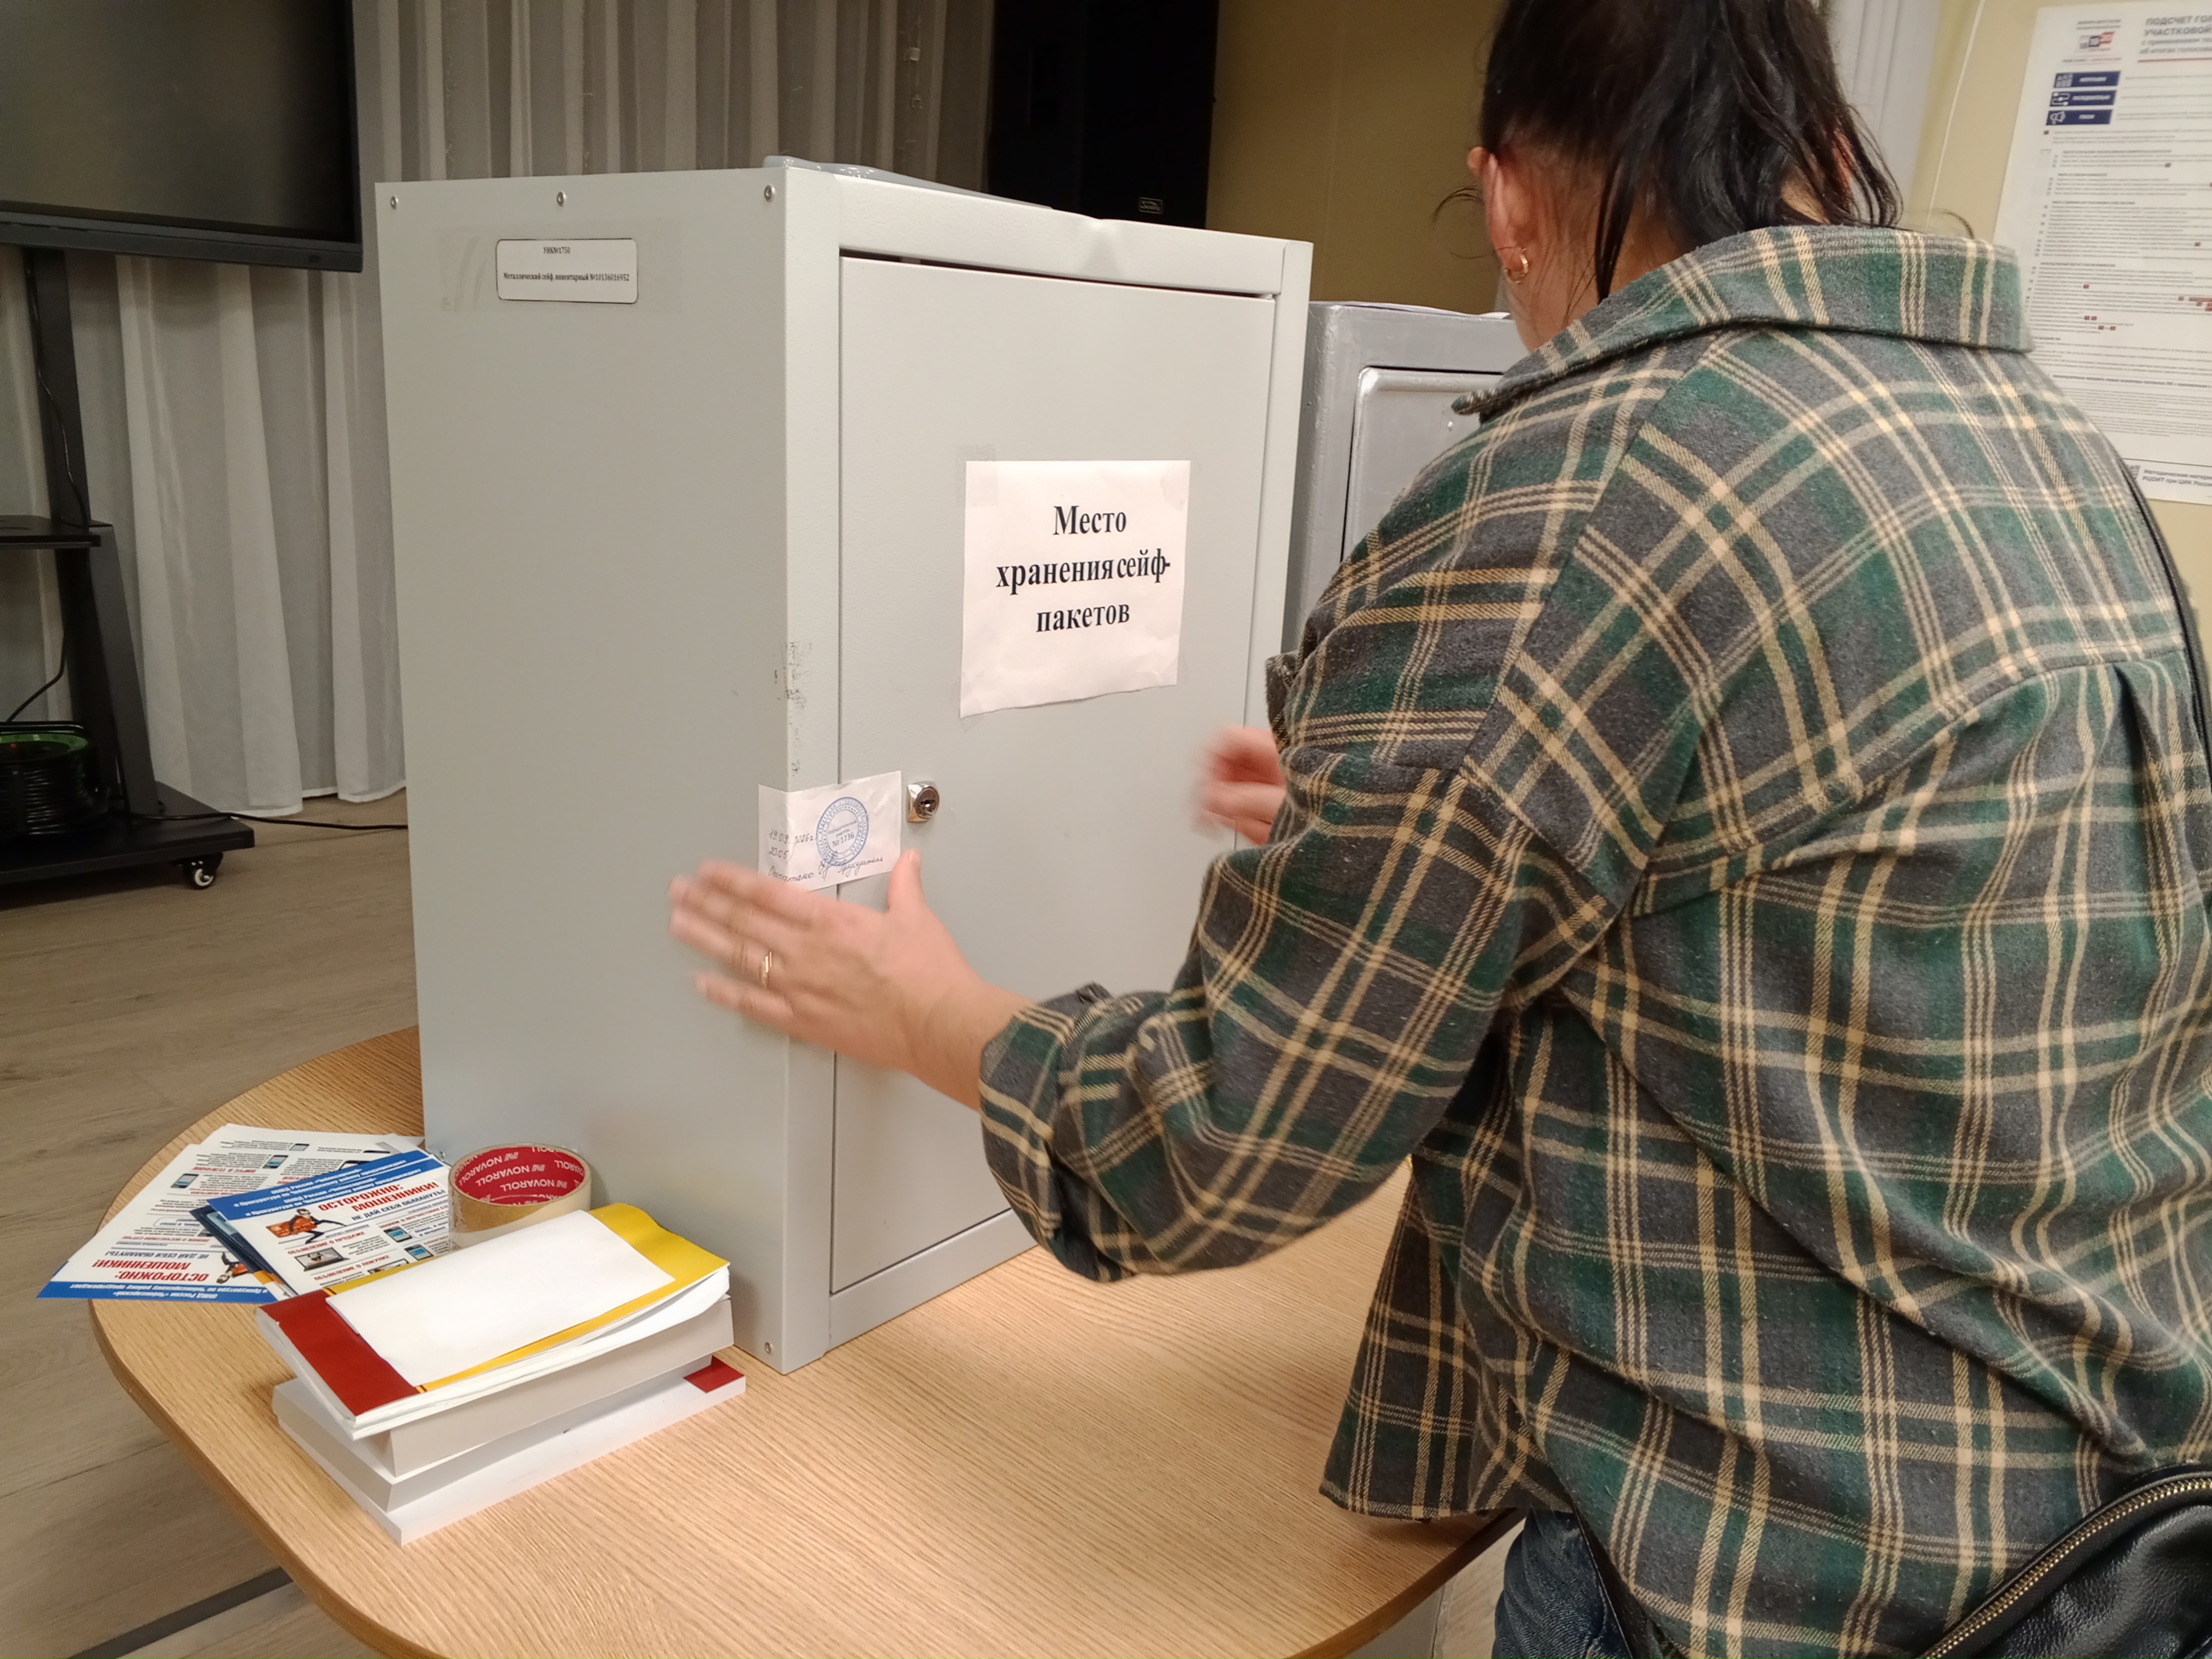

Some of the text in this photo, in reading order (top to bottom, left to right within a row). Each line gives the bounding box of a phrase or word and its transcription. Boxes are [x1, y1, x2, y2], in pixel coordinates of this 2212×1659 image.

[2146, 16, 2193, 26] ПОДСЧЕТ
[1053, 505, 1127, 535] Место
[996, 548, 1171, 595] хранения сейф-
[1036, 604, 1130, 632] пакетов
[458, 1155, 502, 1185] NOVAROLL
[475, 1165, 530, 1187] NOVAROLL
[351, 1182, 440, 1212] МОШЕННИКИ!
[500, 1179, 555, 1191] NOVAROLL
[318, 1184, 404, 1212] ОСТОРОЖНО:
[363, 1209, 380, 1218] ДАЙ
[381, 1205, 402, 1213] СЕБЯ
[92, 1259, 192, 1270] МОШЕННИКИ!
[115, 1271, 209, 1282] ОСТОРОЖНО:
